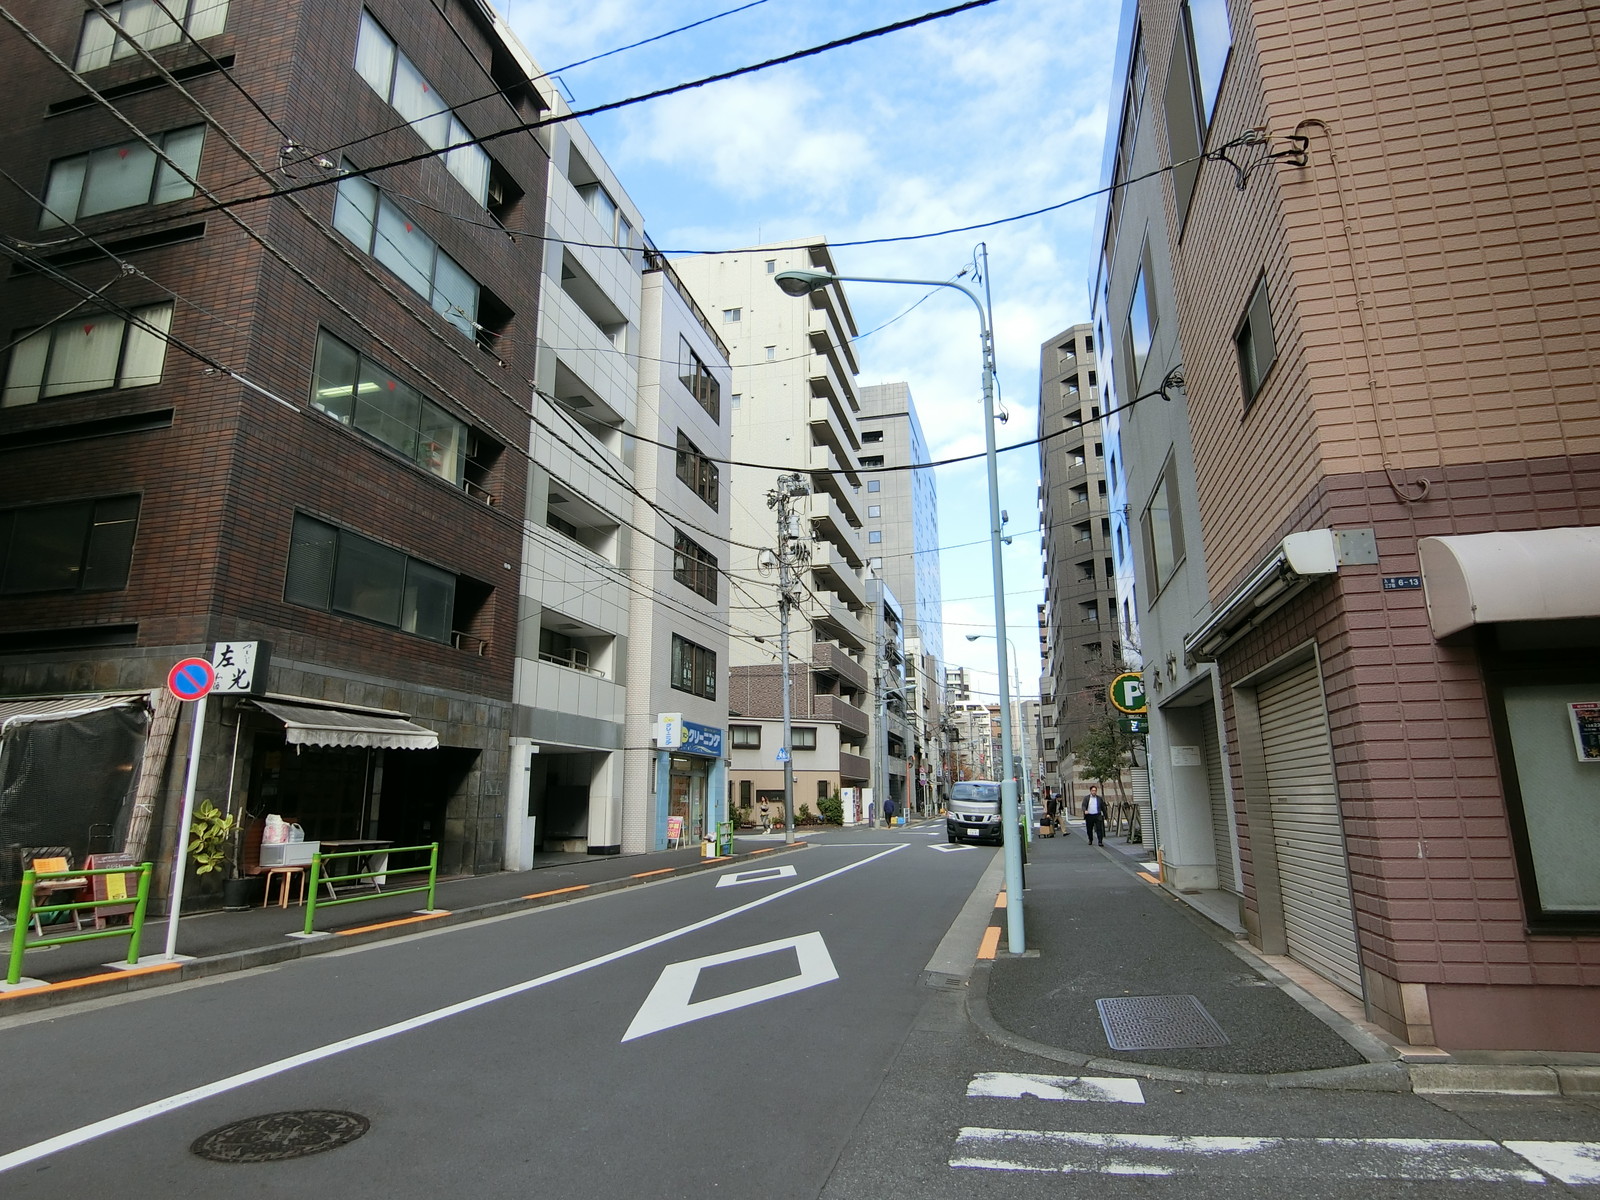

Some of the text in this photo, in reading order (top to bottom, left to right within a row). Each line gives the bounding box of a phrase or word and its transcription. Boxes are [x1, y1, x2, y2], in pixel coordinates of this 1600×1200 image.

[1398, 578, 1419, 586] 6-13
[1123, 680, 1143, 706] P
[688, 728, 721, 748] クリーニング
